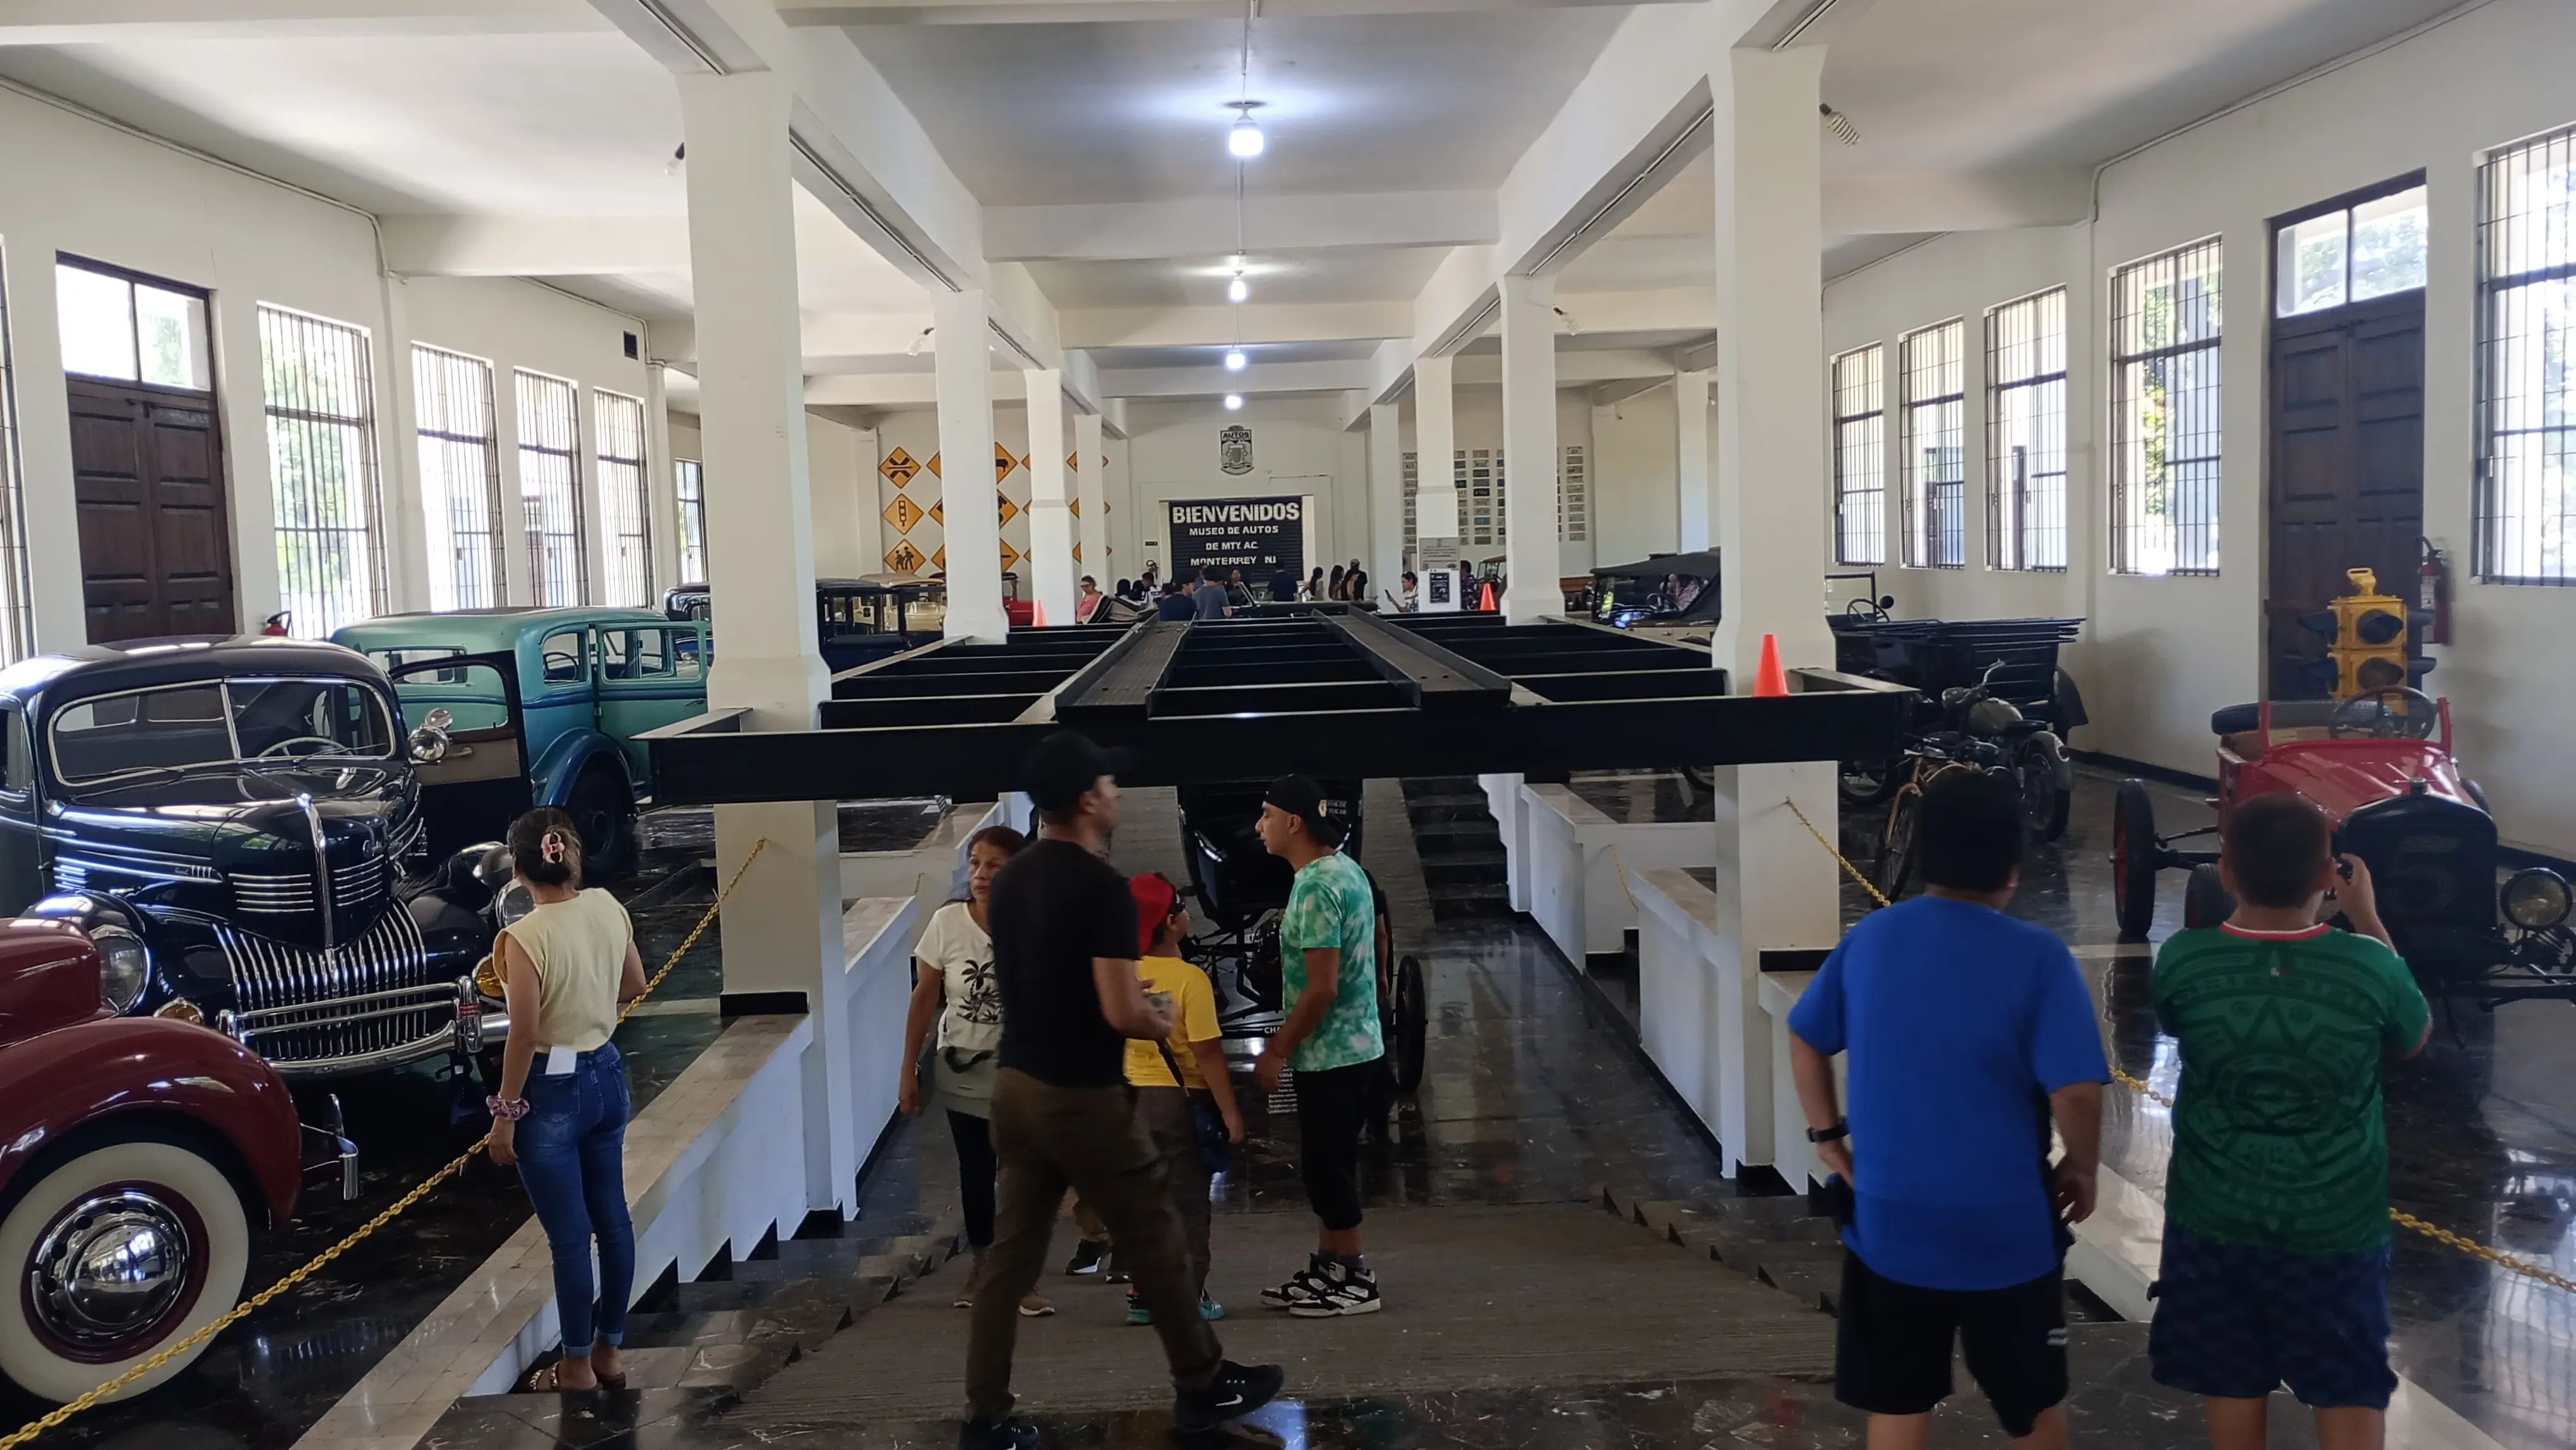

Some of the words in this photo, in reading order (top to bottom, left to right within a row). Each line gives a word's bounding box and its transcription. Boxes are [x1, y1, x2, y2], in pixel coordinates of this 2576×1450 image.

[1222, 431, 1249, 440] AUTOS
[1172, 502, 1300, 524] BIENVENIDOS
[1189, 527, 1225, 536] MUSEO
[1227, 526, 1241, 535] DE
[1242, 525, 1279, 534] AUTOS
[1205, 542, 1219, 551] DE
[1190, 556, 1257, 566] MONTERREY
